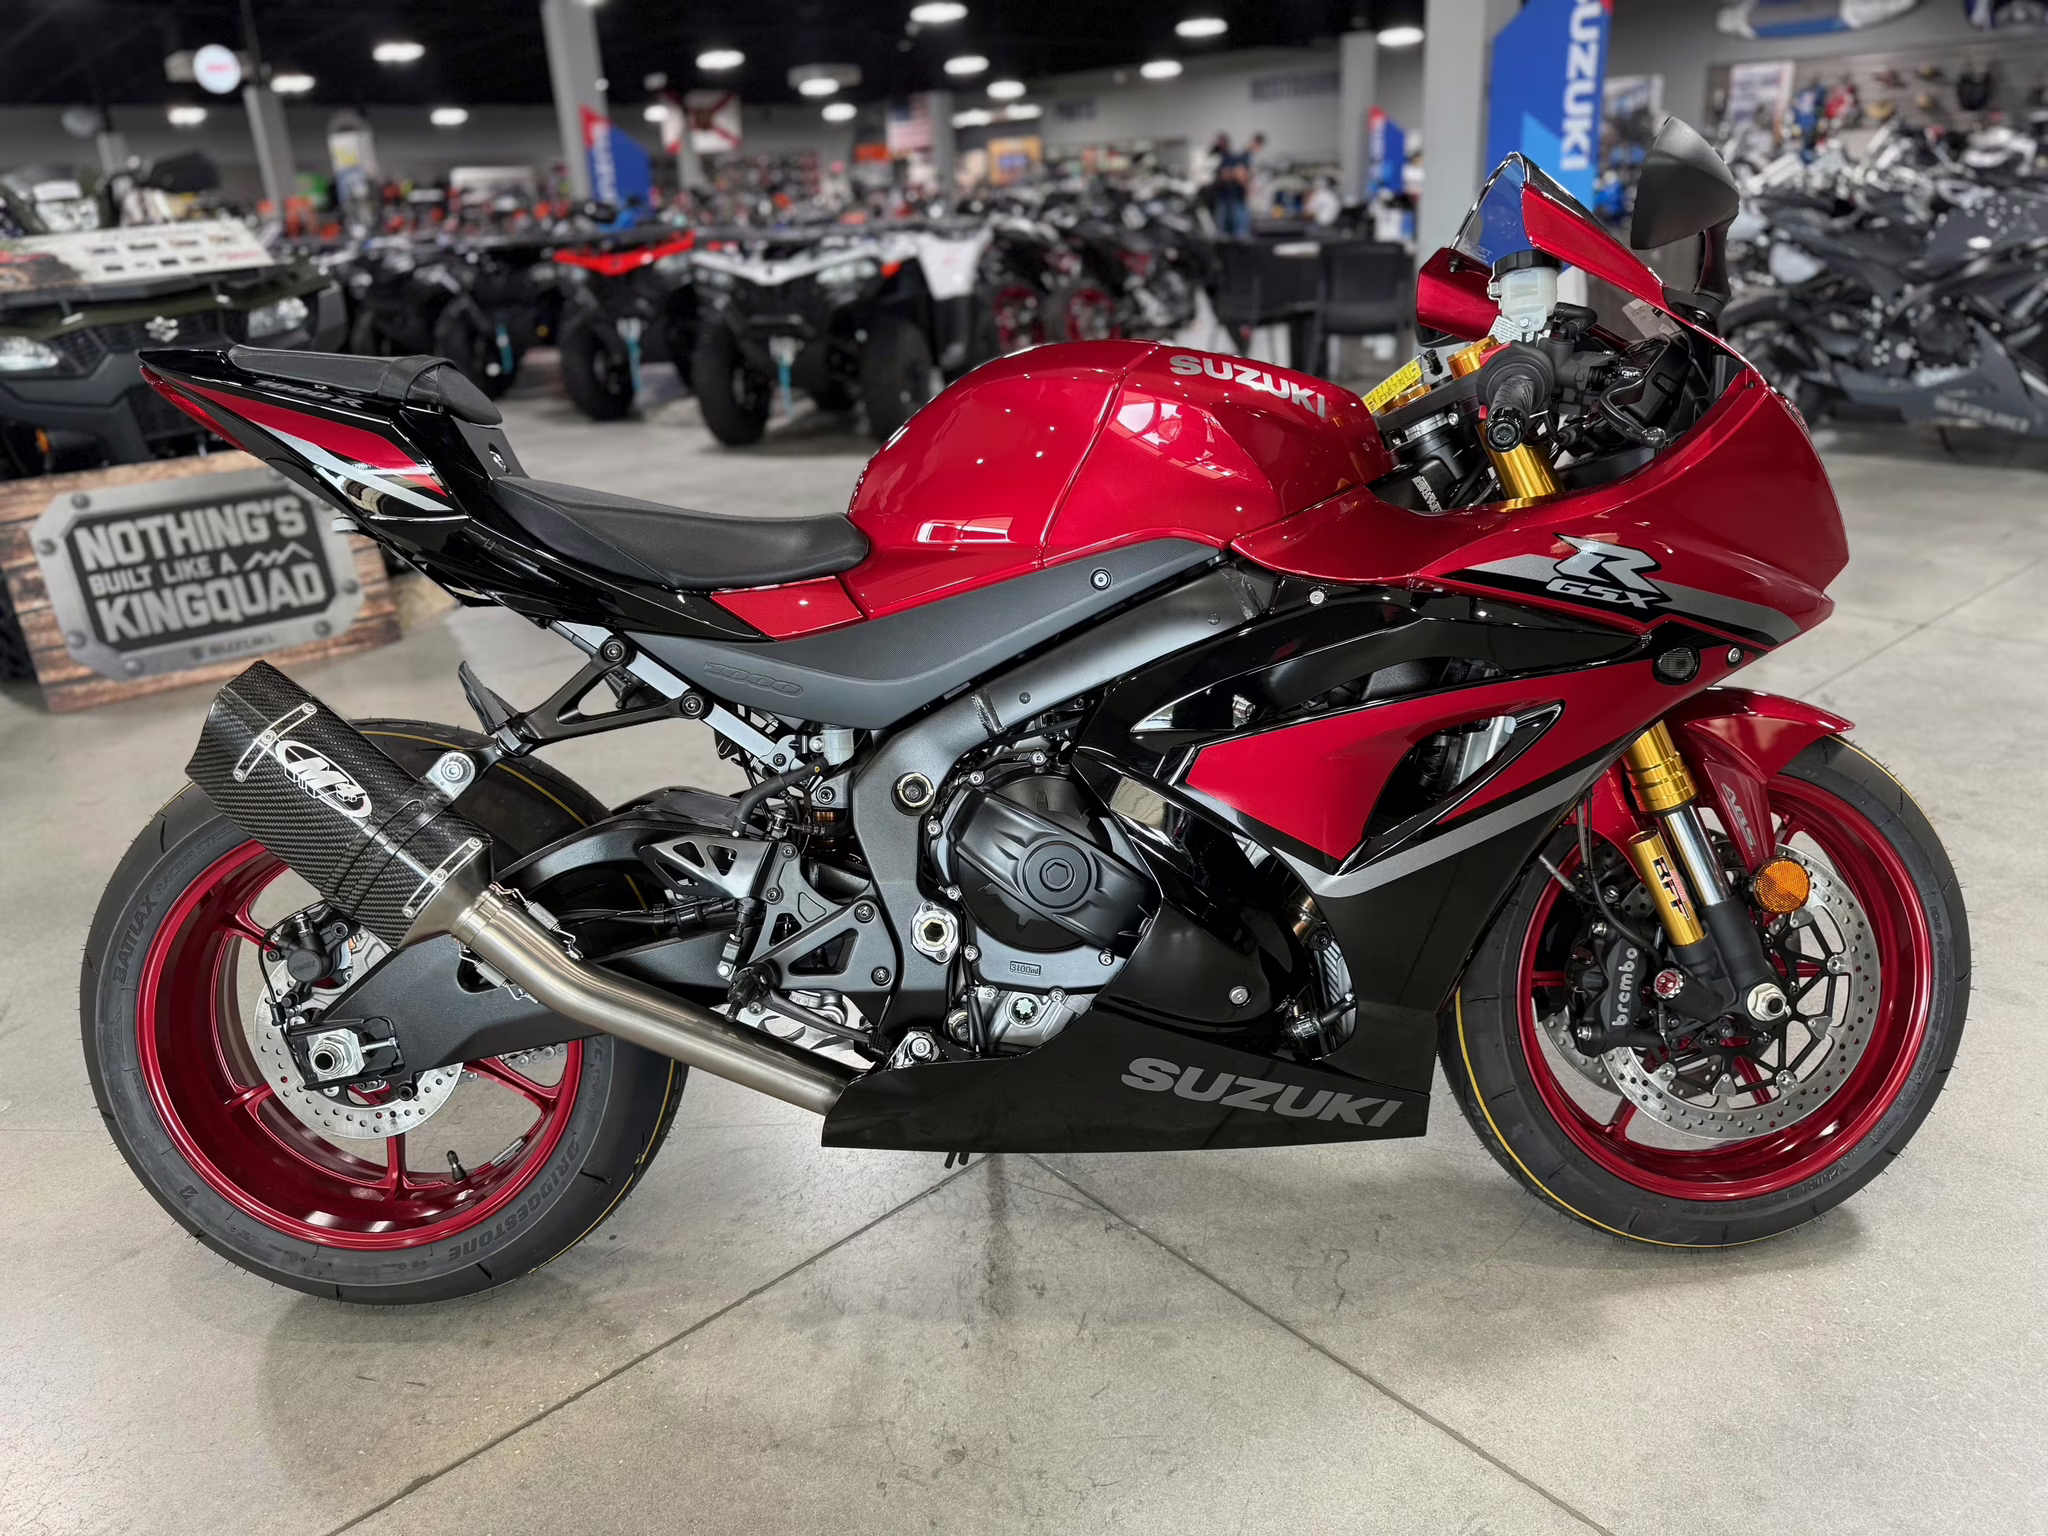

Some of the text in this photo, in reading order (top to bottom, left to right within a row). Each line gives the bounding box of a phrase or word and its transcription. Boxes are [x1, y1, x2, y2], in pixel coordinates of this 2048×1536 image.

[1559, 0, 1604, 170] UZUKI
[1169, 355, 1327, 419] SUZUKI
[73, 495, 308, 571] NOTHING'S
[88, 552, 238, 597] BUILT LIKE A
[95, 562, 328, 643] KINGQUAD
[1546, 578, 1661, 609] GSX
[704, 662, 804, 697] 1000
[1720, 782, 1757, 849] ABS
[112, 894, 158, 984] BATTLAX
[1011, 963, 1039, 975] 3100ml
[1612, 947, 1638, 1026] brembo
[1121, 1057, 1403, 1128] SUZUKI
[448, 1138, 580, 1262] BRIDGESTONE
